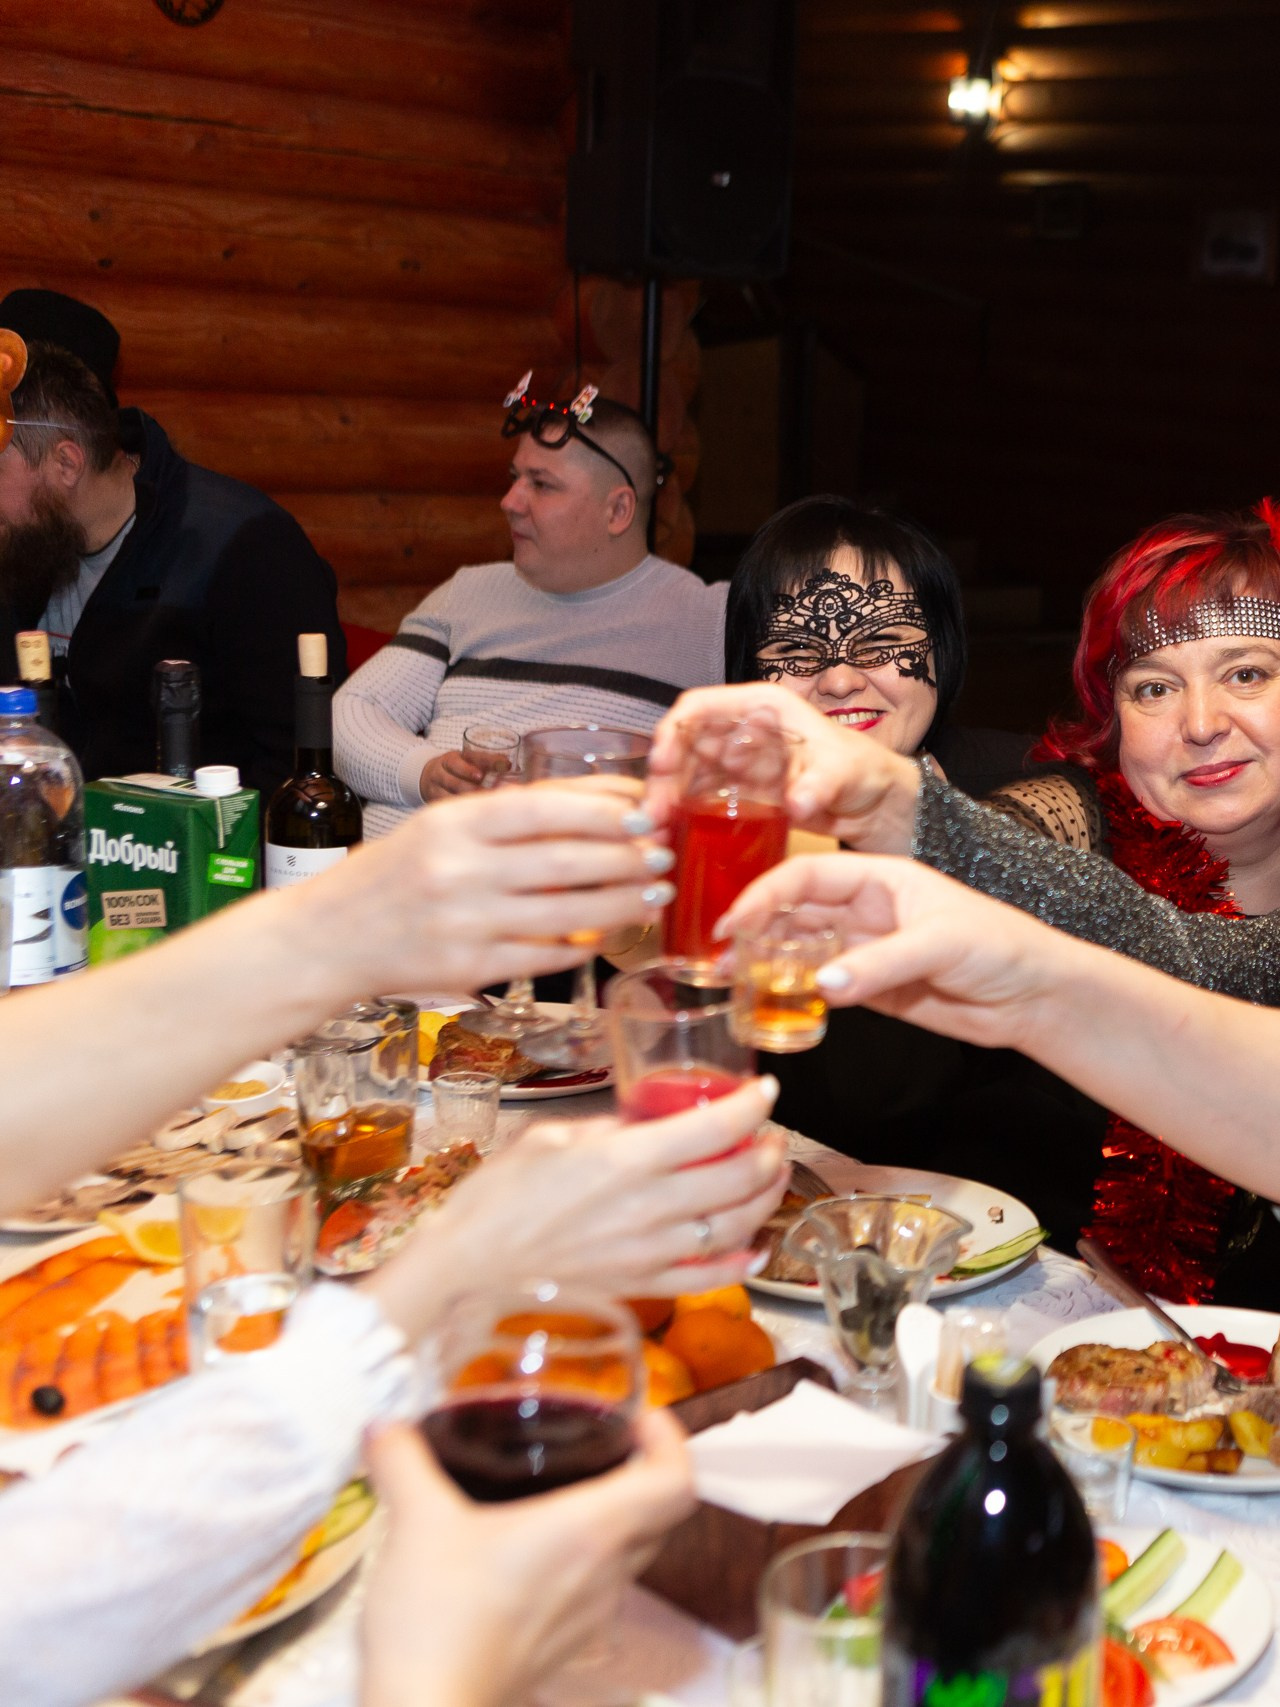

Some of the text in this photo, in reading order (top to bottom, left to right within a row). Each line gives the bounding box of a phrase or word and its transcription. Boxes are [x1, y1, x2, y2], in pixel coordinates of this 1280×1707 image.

[88, 828, 177, 874] Добрый
[105, 894, 160, 909] 100% СОК
[110, 913, 130, 926] БЕЗ
